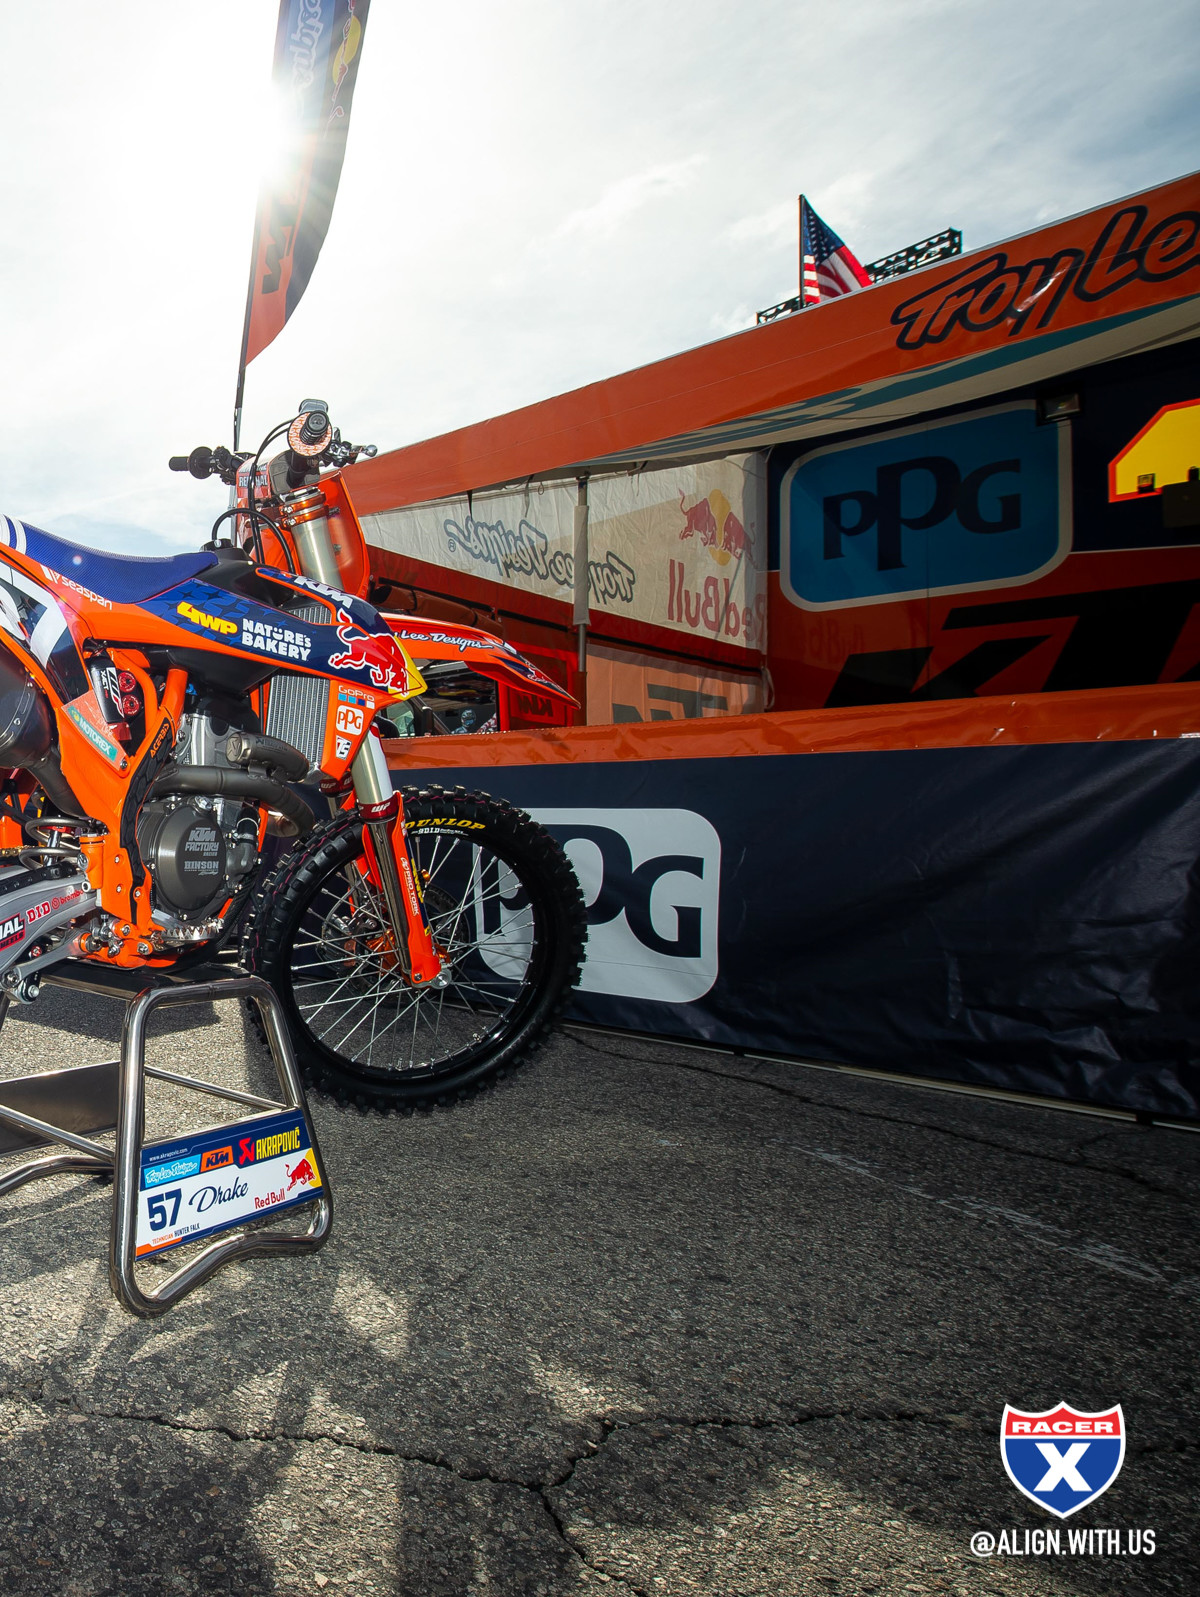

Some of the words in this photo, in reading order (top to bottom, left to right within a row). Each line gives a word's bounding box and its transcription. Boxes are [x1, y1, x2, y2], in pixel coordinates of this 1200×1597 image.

[890, 249, 1086, 351] Troy
[822, 455, 1022, 572] PPG
[61, 574, 113, 611] seaspan
[293, 575, 353, 609] KTM
[176, 601, 238, 635] 4WP
[241, 630, 311, 661] BAKERY
[400, 629, 429, 641] Lee
[429, 632, 494, 652] Designs
[338, 685, 375, 701] GoPro
[337, 708, 362, 731] PPG
[80, 716, 113, 756] MOTOREX
[149, 723, 170, 759] ACERBIS
[188, 827, 216, 841] KTM
[404, 817, 486, 830] DUNLOP
[184, 842, 219, 852] FACTORY
[406, 869, 414, 890] PRO
[59, 889, 84, 905] brembo
[409, 890, 420, 916] TORK
[205, 1150, 229, 1168] KTM
[188, 1176, 249, 1213] Drake
[254, 1195, 271, 1209] Red
[270, 1188, 285, 1206] Bull
[147, 1188, 182, 1232] 57
[152, 1233, 174, 1245] TECHNICIAN
[174, 1226, 190, 1238] HUNTER
[190, 1222, 201, 1233] FALK
